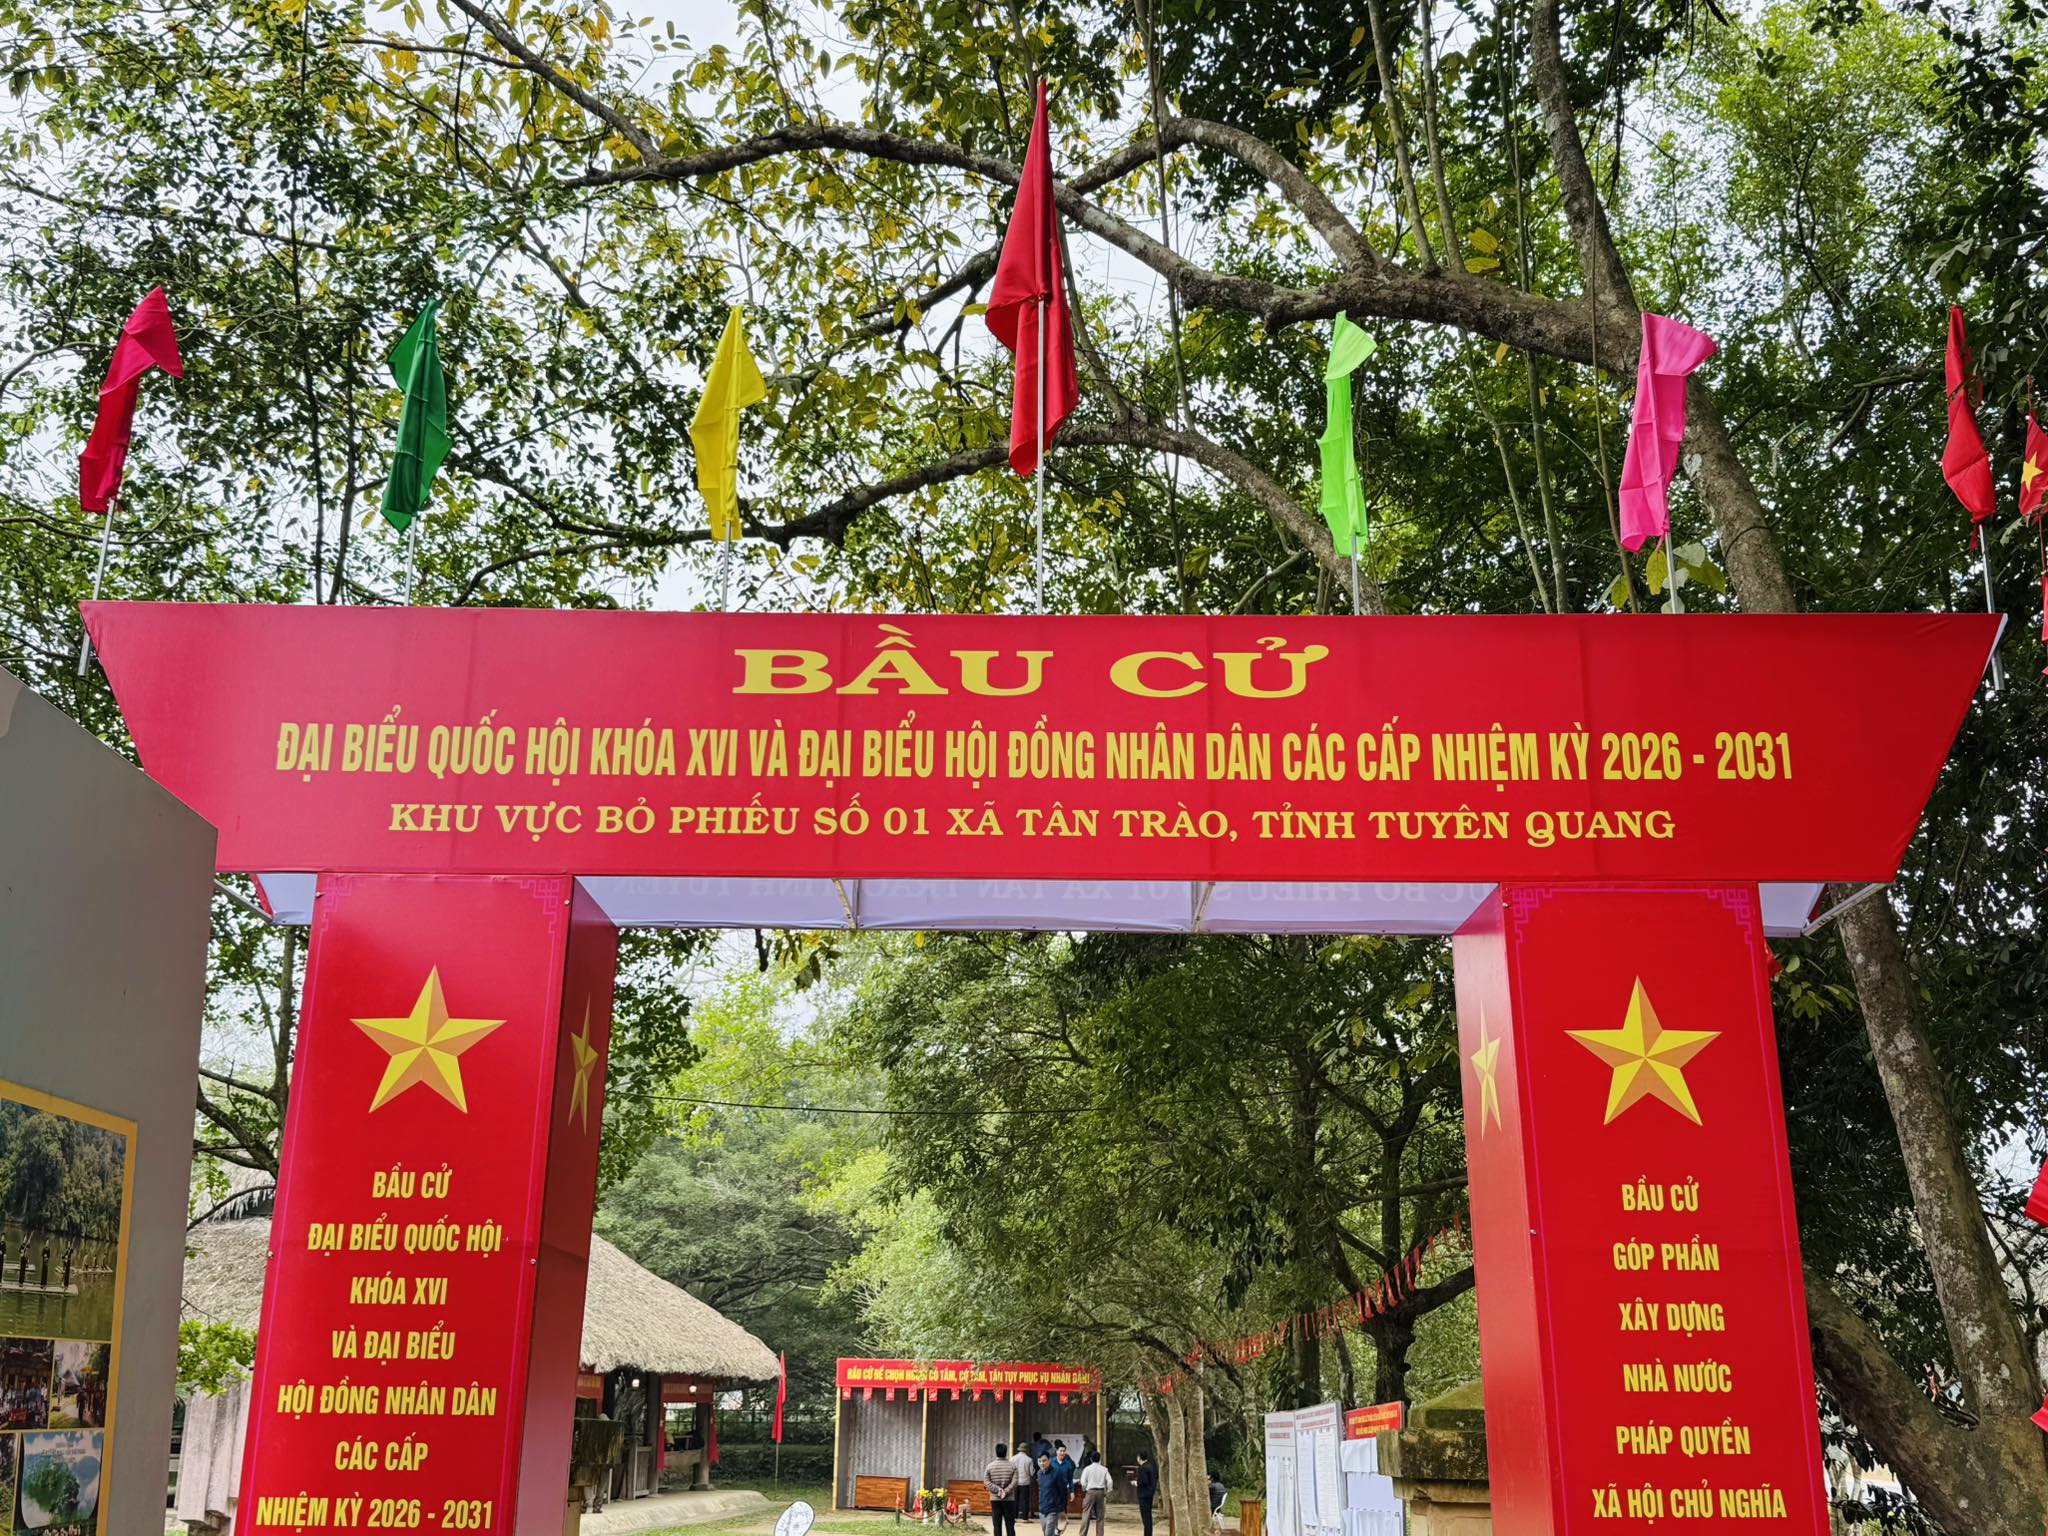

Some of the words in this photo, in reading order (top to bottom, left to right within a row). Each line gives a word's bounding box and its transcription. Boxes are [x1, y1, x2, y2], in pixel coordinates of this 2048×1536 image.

[733, 623, 1053, 697] BẦU
[1110, 635, 1330, 699] CỬ
[278, 725, 333, 782] ĐẠI
[343, 708, 418, 772] BIỂU
[428, 718, 515, 779] QUỐC
[526, 719, 580, 785] HỘI
[591, 718, 675, 776] KHÓA
[687, 729, 738, 776] XVI
[749, 721, 788, 776] VÀ
[799, 730, 851, 788] ĐẠI
[863, 712, 934, 777] BIỂU
[946, 720, 996, 788] HỘI
[1008, 717, 1094, 779] ĐỒNG
[1107, 723, 1194, 779] NHÂN
[1206, 723, 1271, 780] DÂN
[1283, 724, 1345, 781] CÁC
[1357, 717, 1420, 781] CẤP
[1432, 723, 1539, 791] NHIỆM
[1549, 723, 1589, 780] KỲ
[1602, 733, 1682, 780] 2026
[1716, 732, 1791, 779] 2031
[391, 804, 480, 832] KHU
[497, 802, 581, 842] VỰC
[597, 800, 655, 833] BỎ
[671, 799, 799, 834] PHIẾU
[815, 800, 869, 835] SỐ
[884, 808, 928, 834] 01
[948, 809, 1003, 835] XÃ
[1017, 803, 1098, 836] TÂN
[1114, 804, 1237, 841] TRÀO,
[1253, 804, 1355, 838] TỈNH
[1369, 805, 1509, 839] TUYÊN
[1526, 811, 1675, 847] QUANG
[372, 1161, 416, 1199] BẦU
[421, 1163, 453, 1199] CỬ
[1622, 1174, 1665, 1212] BẦU
[1670, 1176, 1700, 1212] CỬ
[308, 1223, 344, 1259] ĐẠI
[350, 1211, 399, 1252] BIỂU
[404, 1213, 460, 1255] QUỐC
[466, 1217, 502, 1258] HỘI
[1613, 1237, 1655, 1271] GÓP
[1661, 1234, 1720, 1271] PHẦN
[350, 1271, 406, 1305] KHÓA
[413, 1277, 447, 1305] XVI
[1618, 1297, 1659, 1331] XÂY
[1666, 1301, 1725, 1338] DỰNG
[332, 1325, 357, 1359] VÀ
[363, 1330, 400, 1365] ĐẠI
[406, 1319, 456, 1360] BIỂU
[1623, 1358, 1669, 1392] NHÀ
[1673, 1358, 1733, 1393] NƯỚC
[277, 1378, 314, 1420] HỘI
[320, 1375, 379, 1415] ĐỒNG
[385, 1381, 446, 1415] NHÂN
[451, 1382, 497, 1416] DÂN
[335, 1435, 379, 1471] CÁC
[385, 1432, 429, 1471] CẤP
[1616, 1418, 1673, 1455] PHÁP
[1680, 1416, 1751, 1459] QUYỀN
[255, 1490, 328, 1533] NHIỆM
[333, 1492, 363, 1527] KỲ
[367, 1498, 421, 1528] 2026
[441, 1499, 492, 1529] 2031
[1592, 1481, 1623, 1518] XÃ
[1628, 1483, 1664, 1524] HỘI
[1670, 1480, 1714, 1519] CHỦ
[1720, 1482, 1788, 1519] NGHĨA
